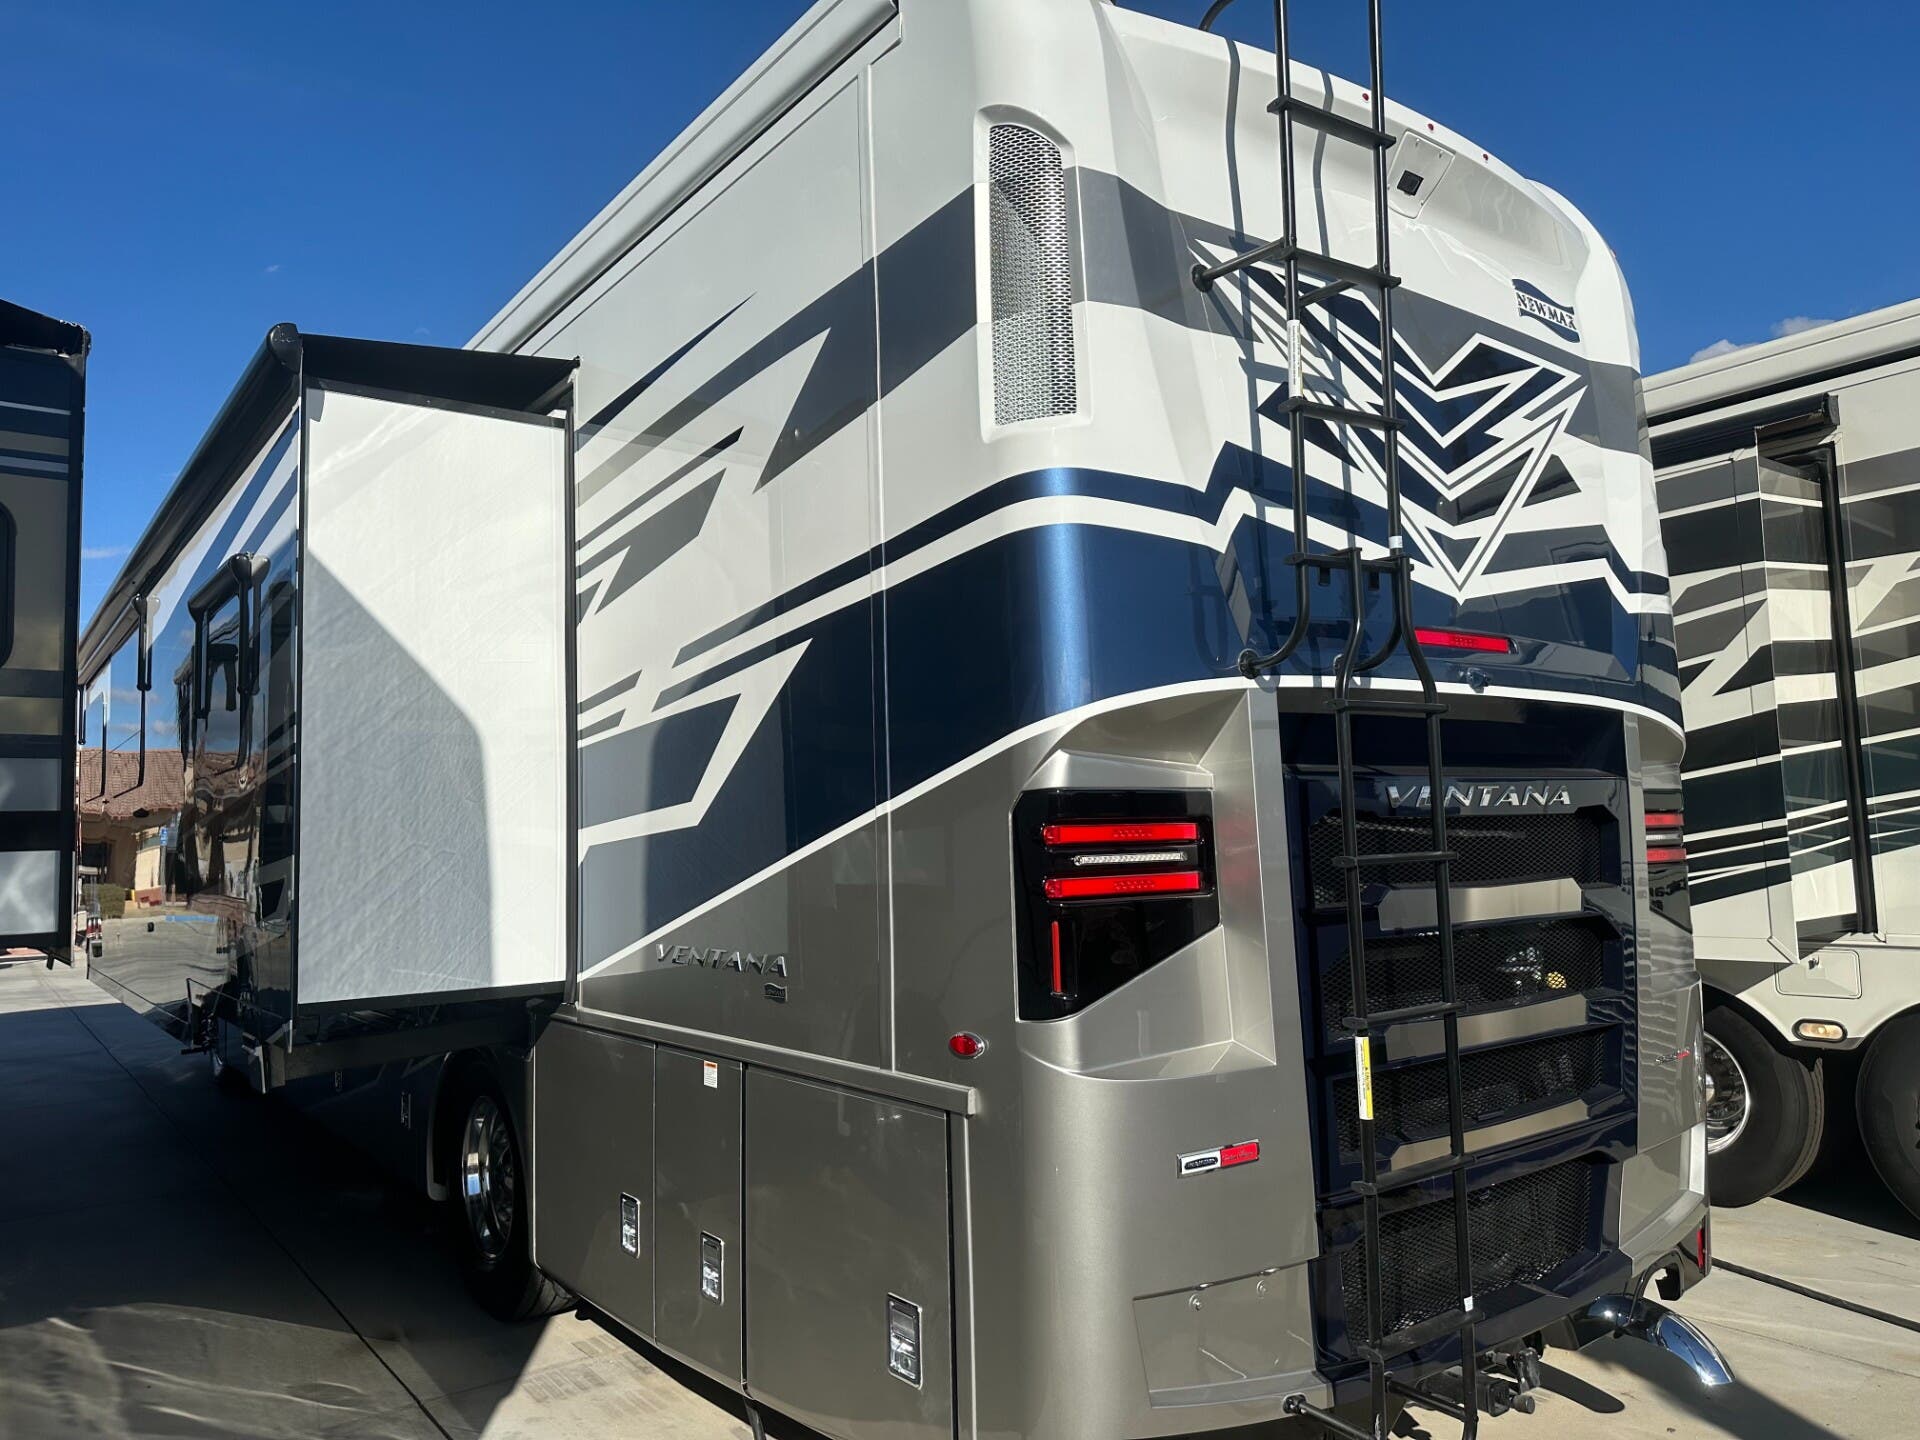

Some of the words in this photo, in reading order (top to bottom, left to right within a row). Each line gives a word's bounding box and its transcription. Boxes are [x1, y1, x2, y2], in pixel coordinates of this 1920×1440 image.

[1516, 292, 1577, 330] NEWMAR
[1386, 785, 1571, 808] VENTANA
[656, 943, 787, 977] VENTANA
